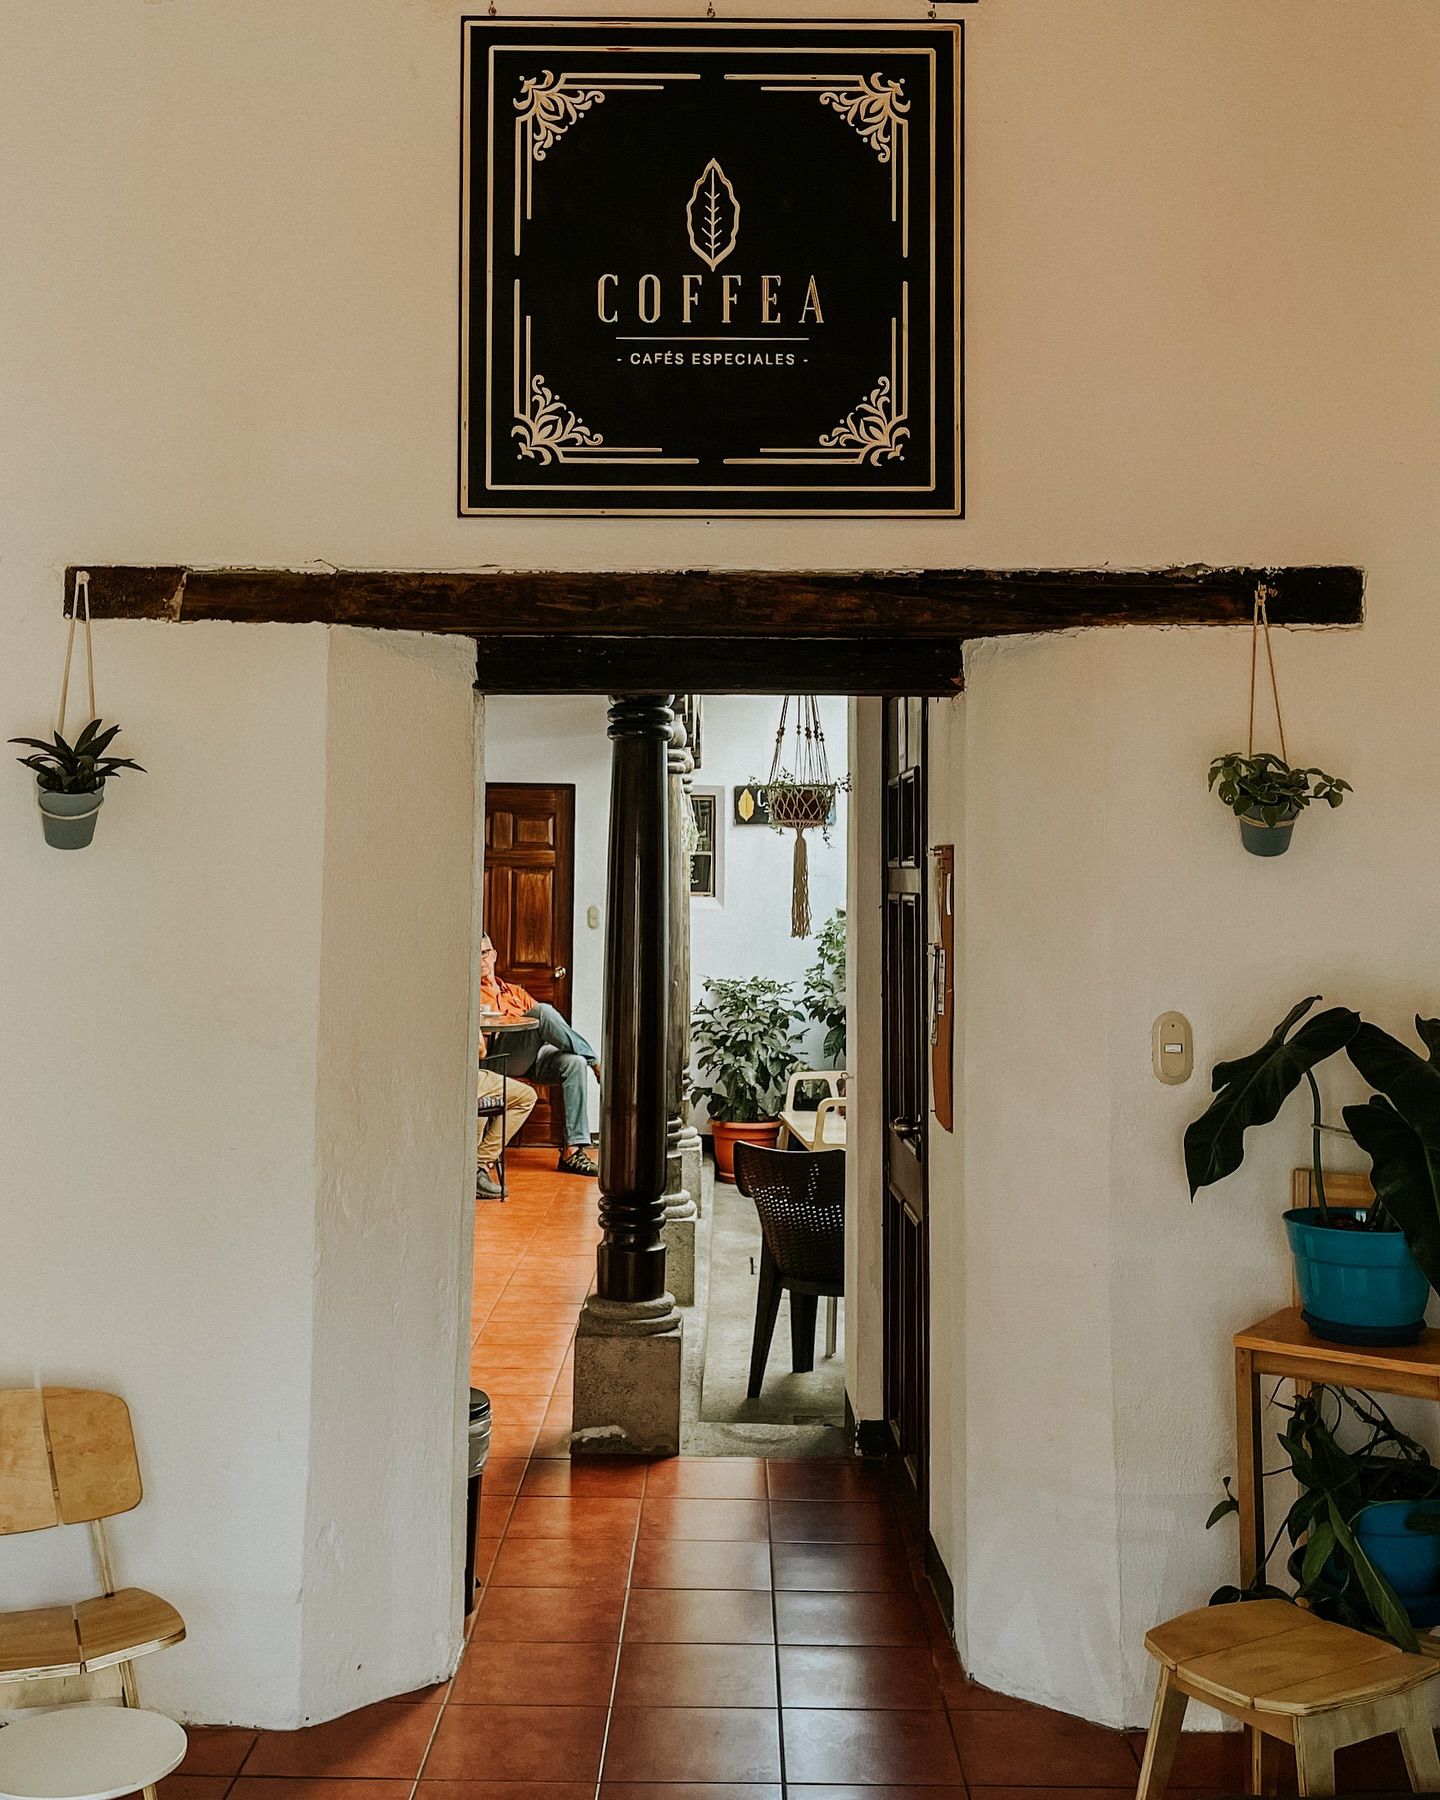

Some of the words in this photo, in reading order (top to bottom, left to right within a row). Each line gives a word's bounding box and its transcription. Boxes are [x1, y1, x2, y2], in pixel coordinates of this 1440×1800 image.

[597, 273, 825, 324] COFFEA
[630, 350, 684, 366] CAFÉS
[691, 352, 796, 366] ESPECIALES
